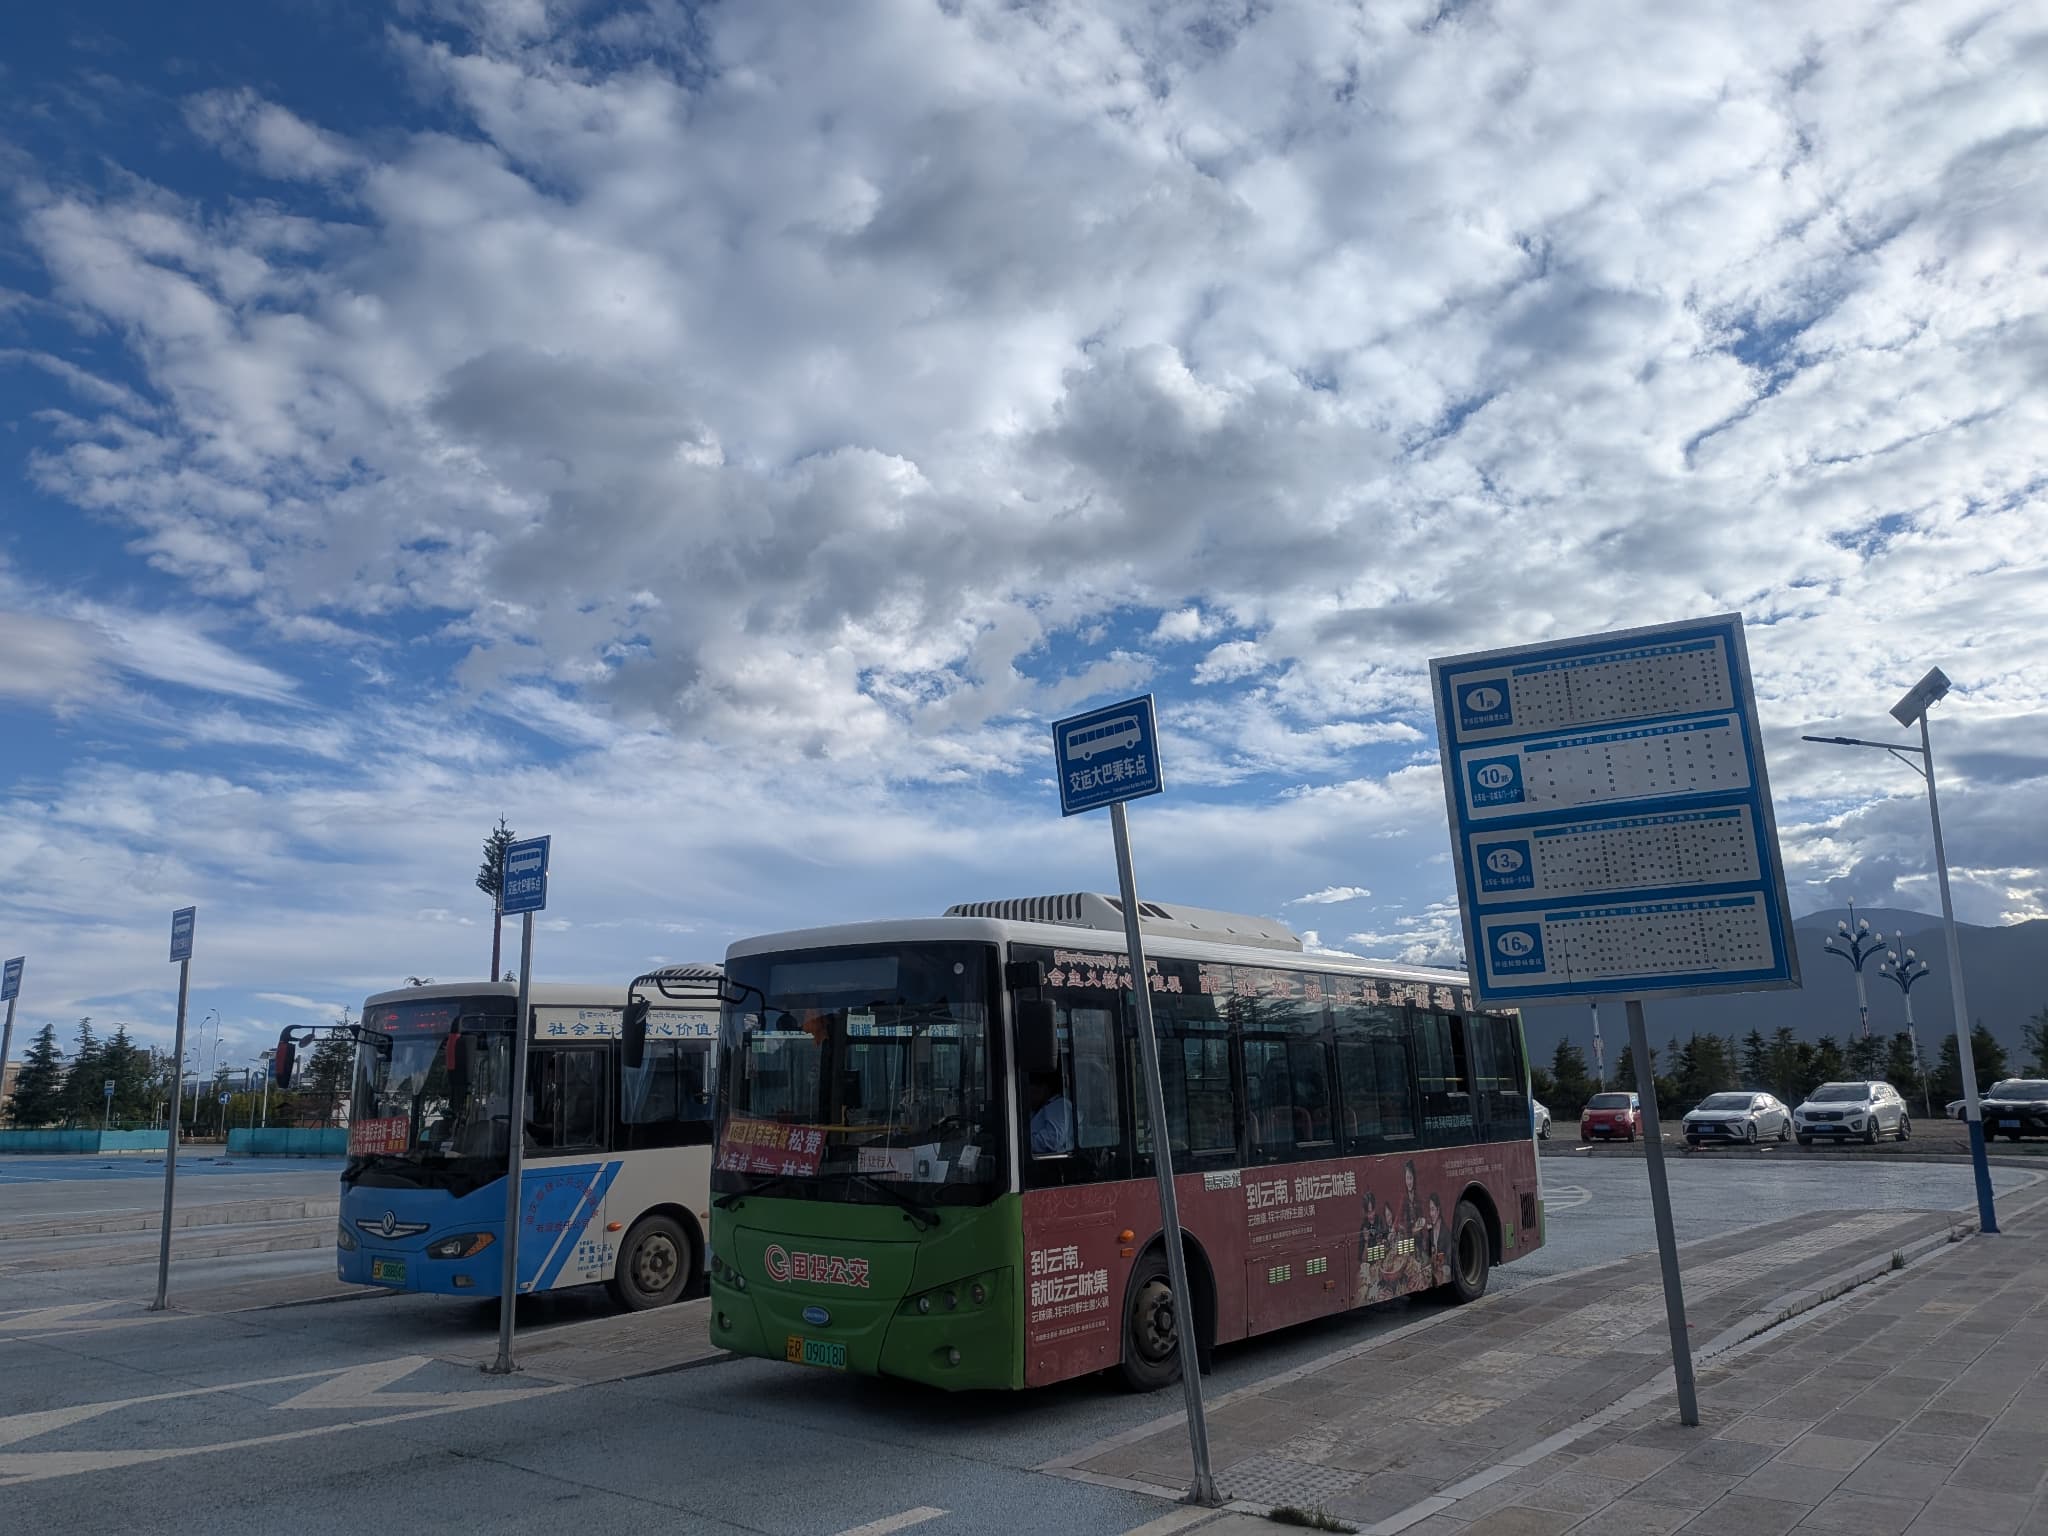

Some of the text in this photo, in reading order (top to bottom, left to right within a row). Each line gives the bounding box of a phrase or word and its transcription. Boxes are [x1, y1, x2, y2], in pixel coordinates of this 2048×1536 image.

[1069, 754, 1148, 793] 交运大巴乘车点
[1480, 766, 1510, 785] 10路
[1490, 850, 1519, 869] 13路
[1501, 934, 1529, 953] 16路
[1043, 966, 1184, 994] 会主义核心值观
[789, 1128, 822, 1155] 松赞
[791, 1251, 870, 1289] 国投公交
[1030, 1268, 1109, 1307] 就吃云味集
